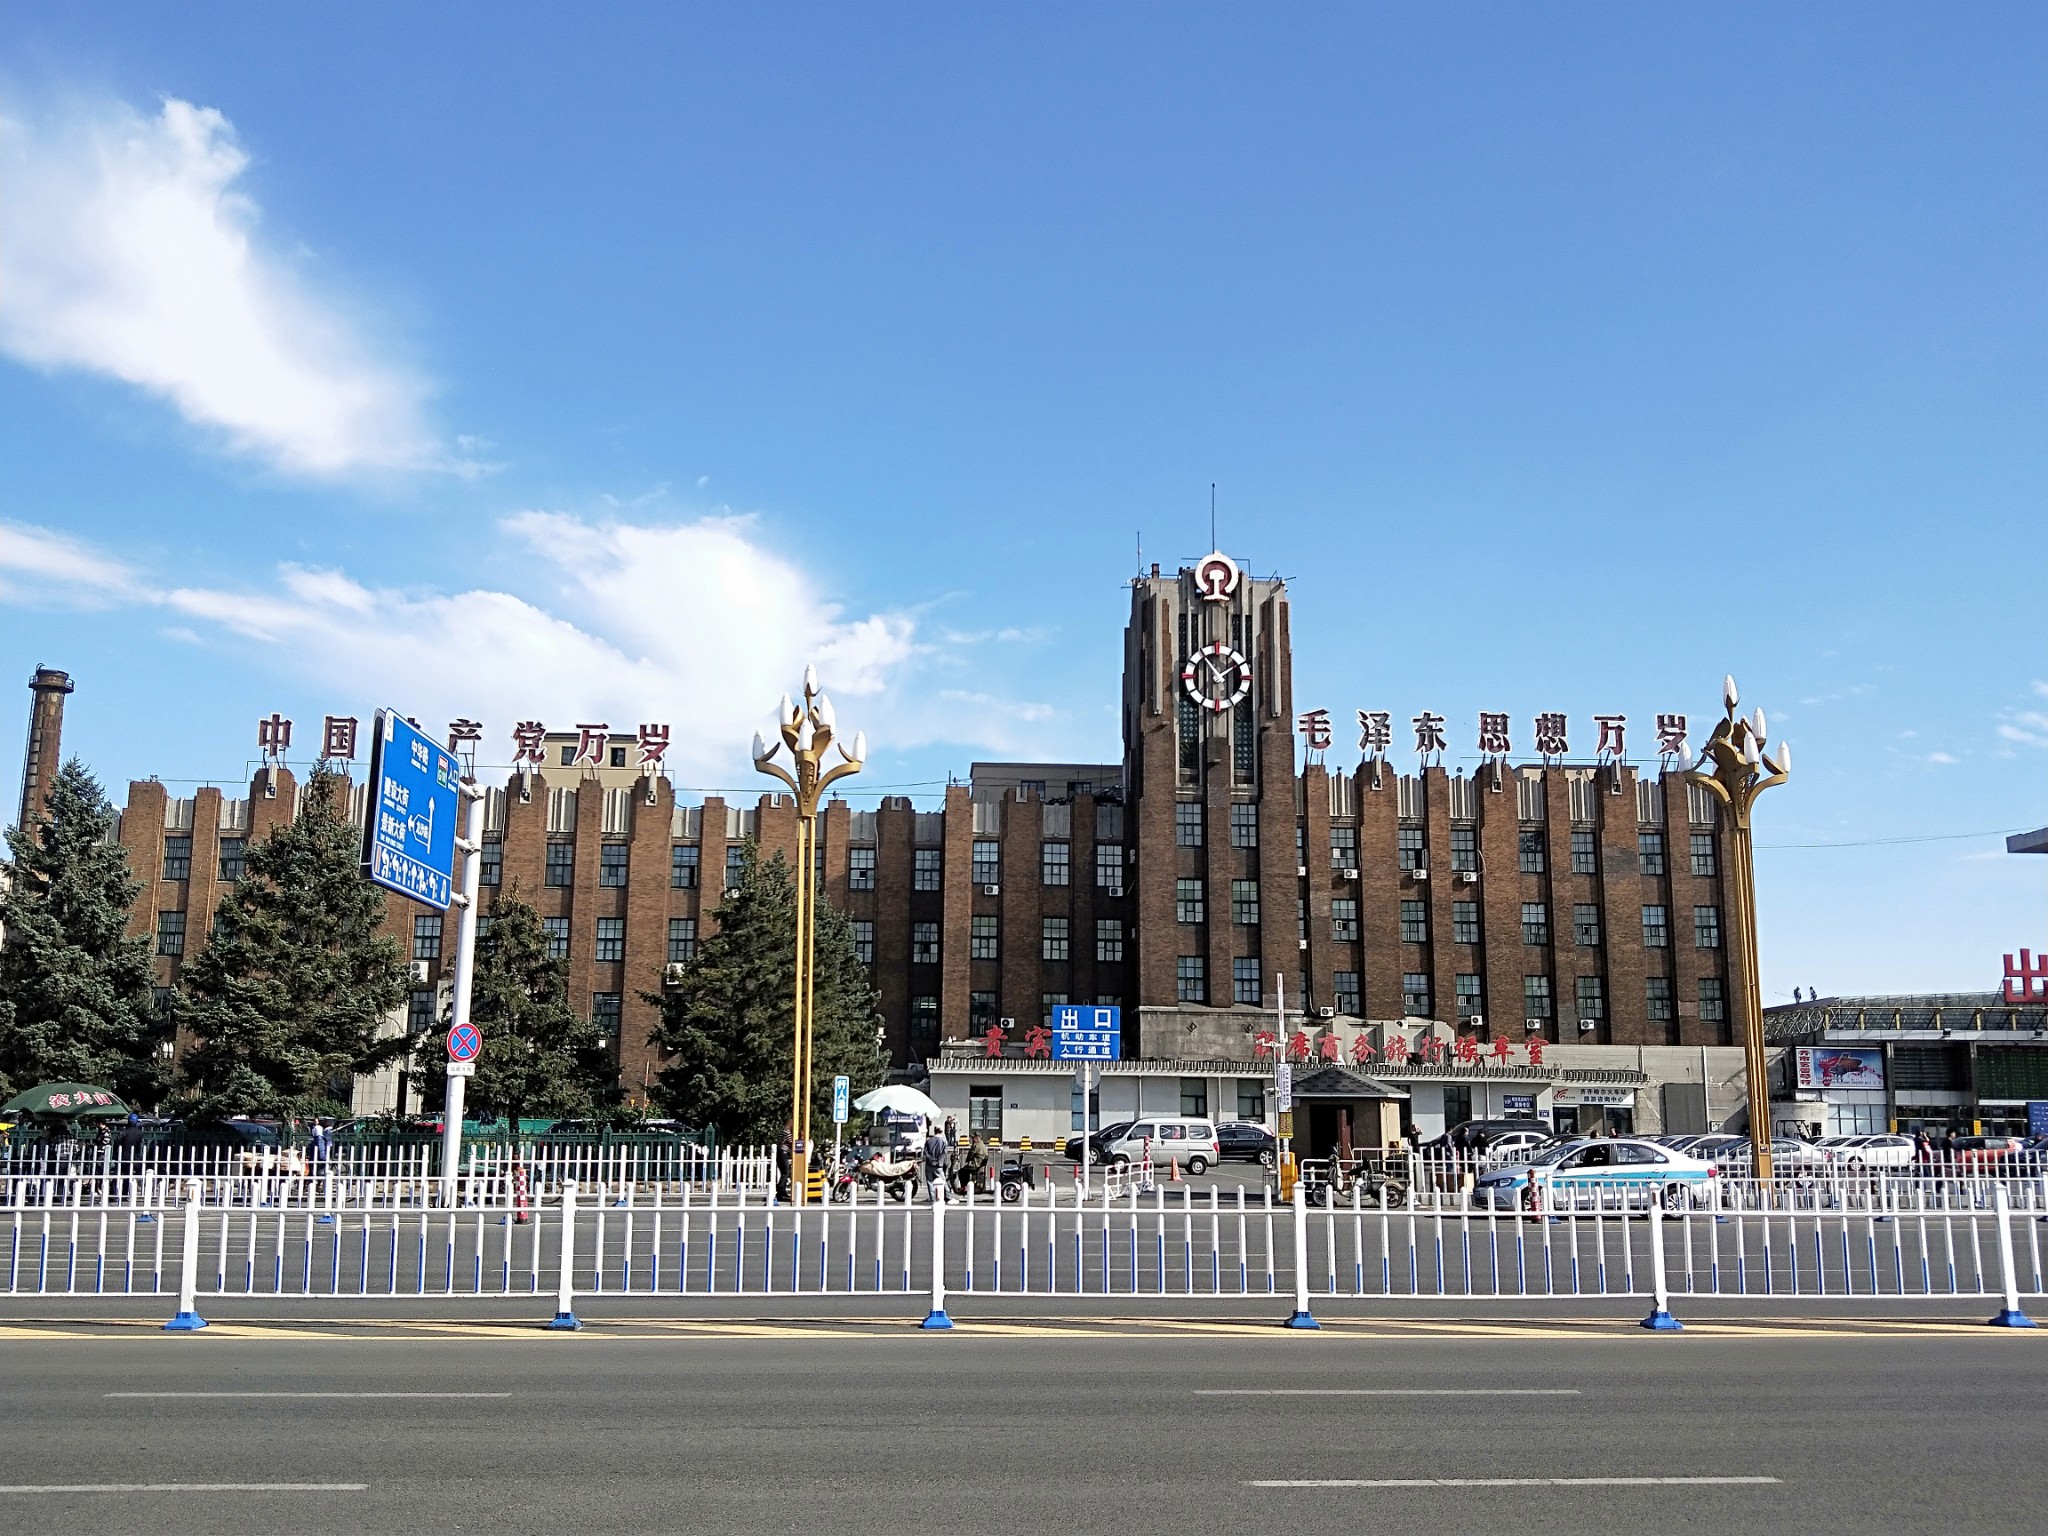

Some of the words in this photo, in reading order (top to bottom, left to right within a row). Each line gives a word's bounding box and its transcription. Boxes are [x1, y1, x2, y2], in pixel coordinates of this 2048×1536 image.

[258, 713, 671, 765] 中国产党万岁
[1297, 709, 1689, 756] 毛泽东思想万岁
[2003, 948, 2048, 1003] 出
[1060, 1008, 1112, 1030] 出口
[1060, 1032, 1111, 1042] 机动车道
[1060, 1045, 1111, 1055] 人行通道
[48, 1090, 114, 1109] 农夫山
